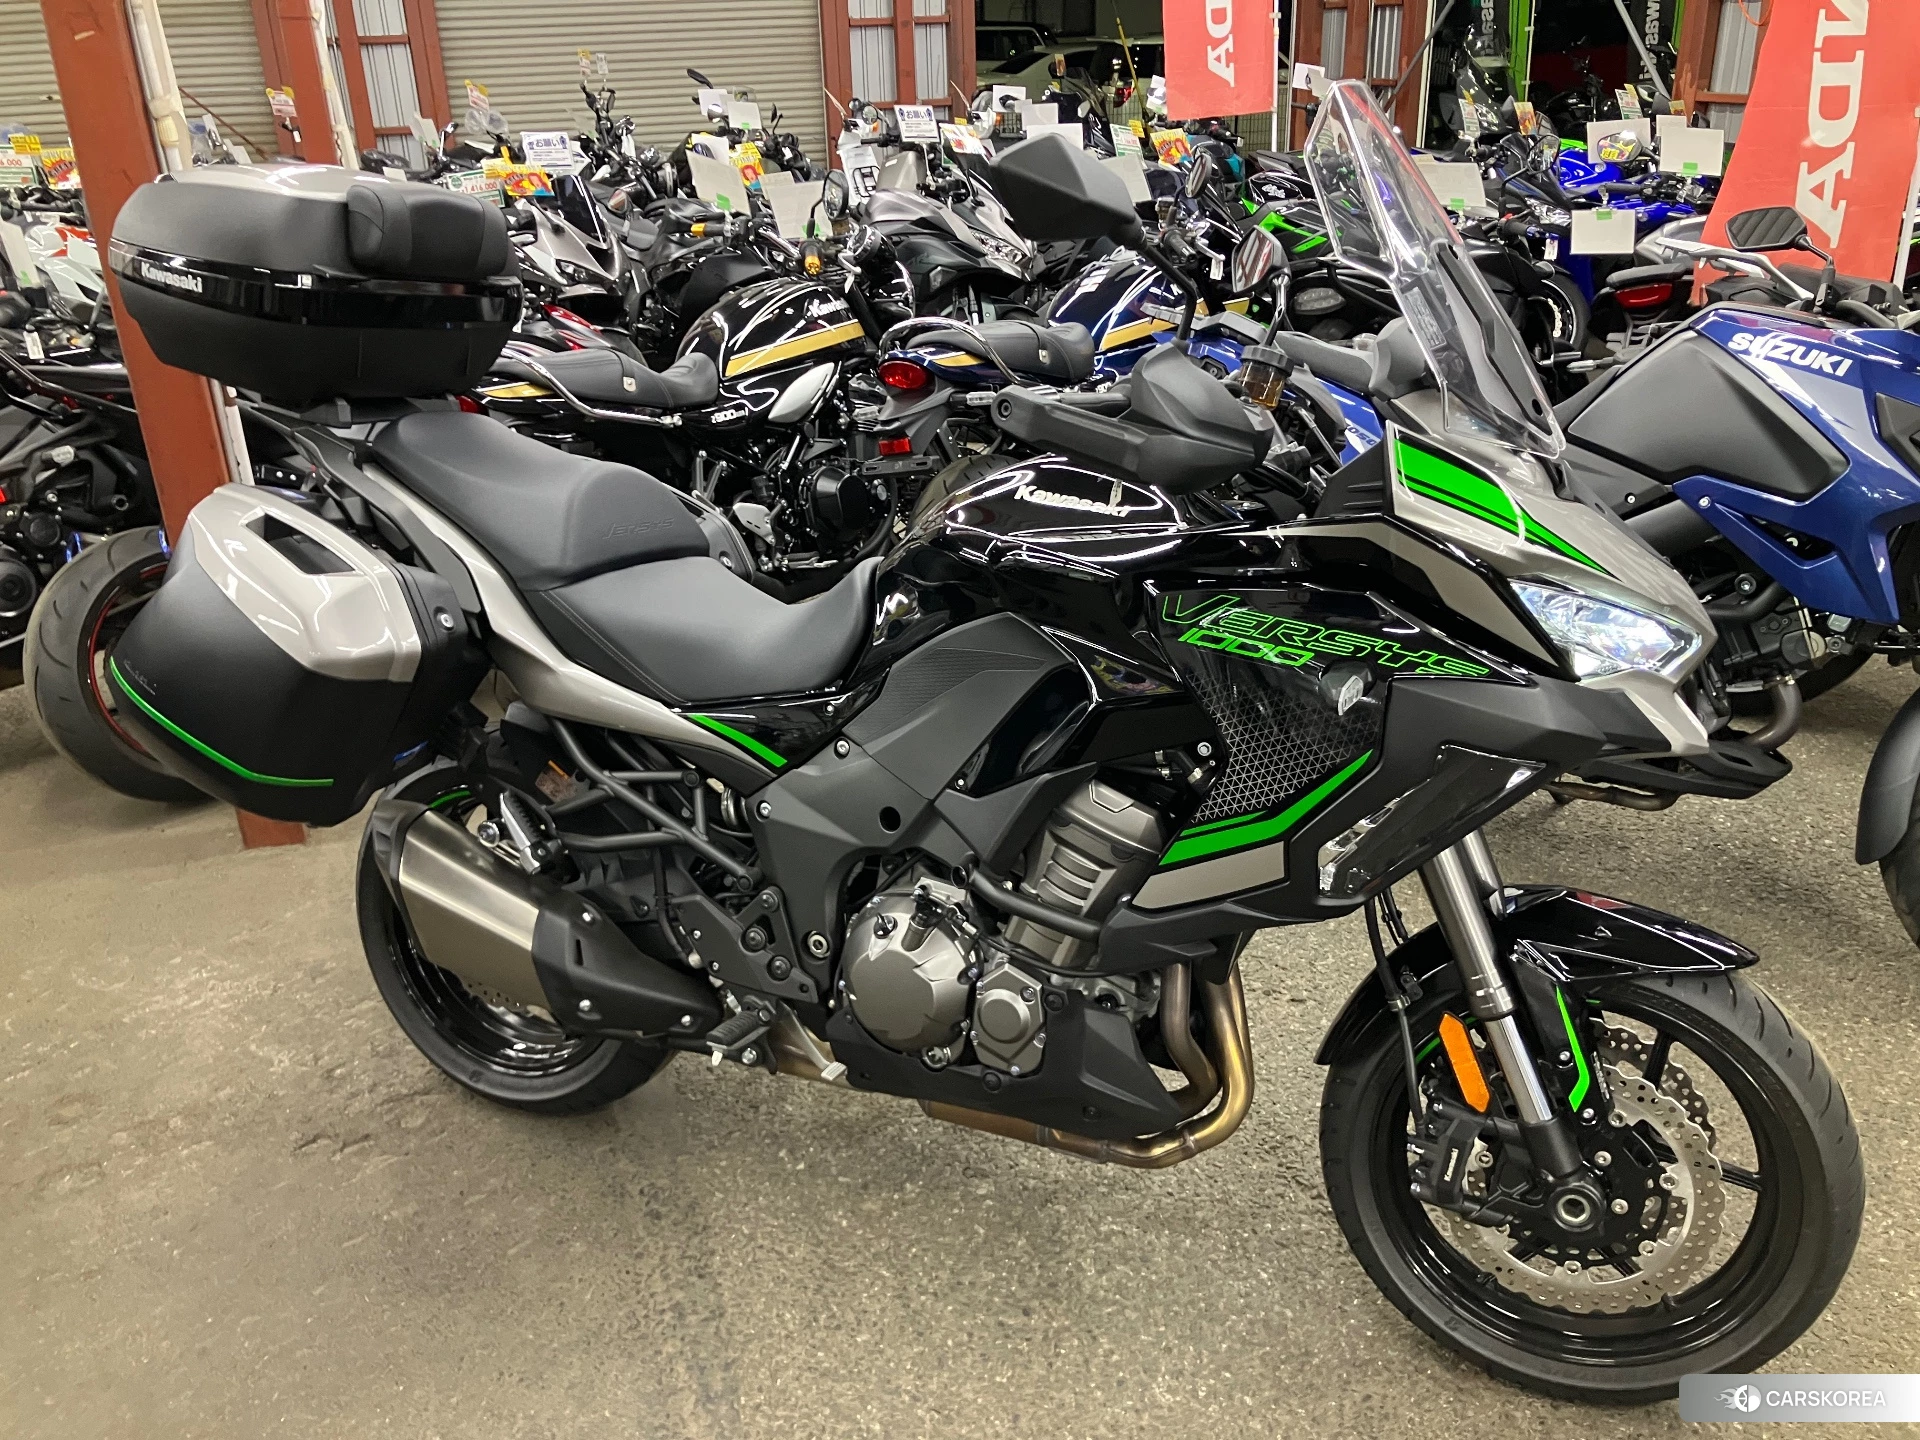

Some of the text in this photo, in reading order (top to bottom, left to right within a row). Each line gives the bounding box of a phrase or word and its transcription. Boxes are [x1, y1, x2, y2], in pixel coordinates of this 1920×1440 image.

[140, 261, 203, 293] Kawasaki
[1727, 332, 1853, 377] SUZUKI
[1013, 484, 1132, 518] Kawasaki
[1177, 627, 1315, 667] 1000
